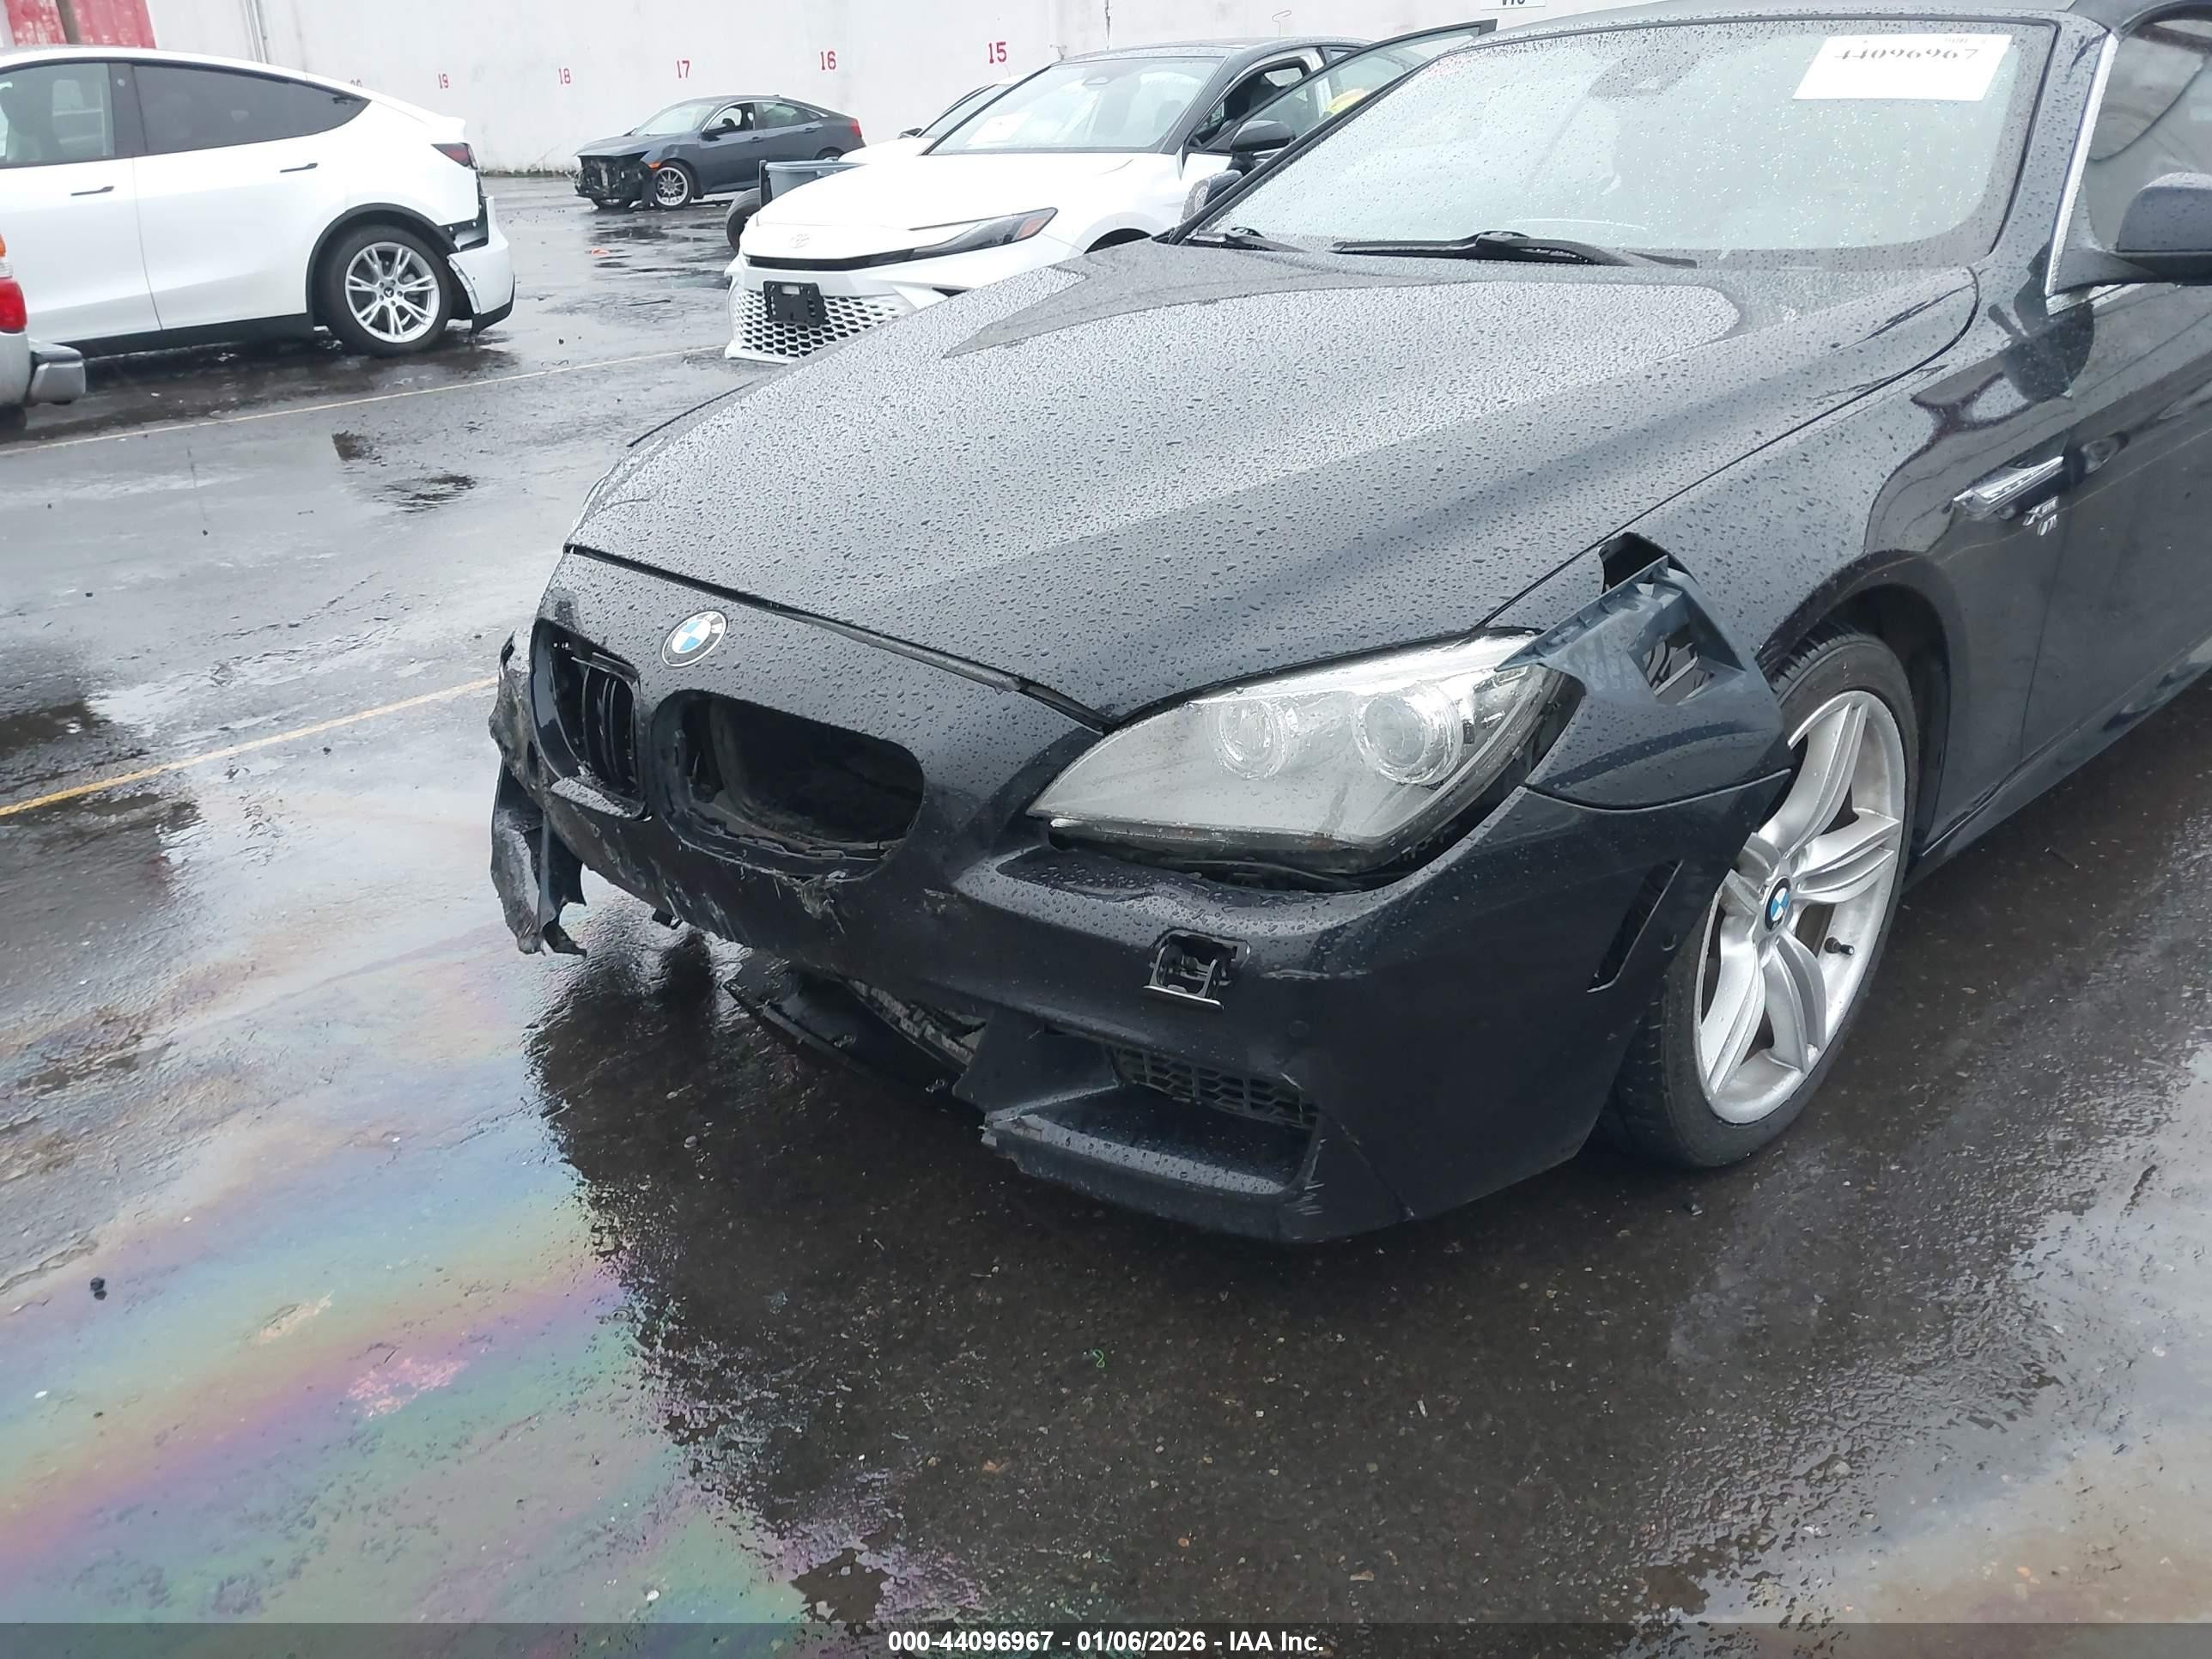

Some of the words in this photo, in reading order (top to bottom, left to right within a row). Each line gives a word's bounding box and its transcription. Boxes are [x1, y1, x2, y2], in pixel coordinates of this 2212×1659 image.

[820, 51, 837, 70] 16
[988, 41, 1007, 64] 15
[558, 68, 571, 84] 18
[676, 60, 690, 78] 17
